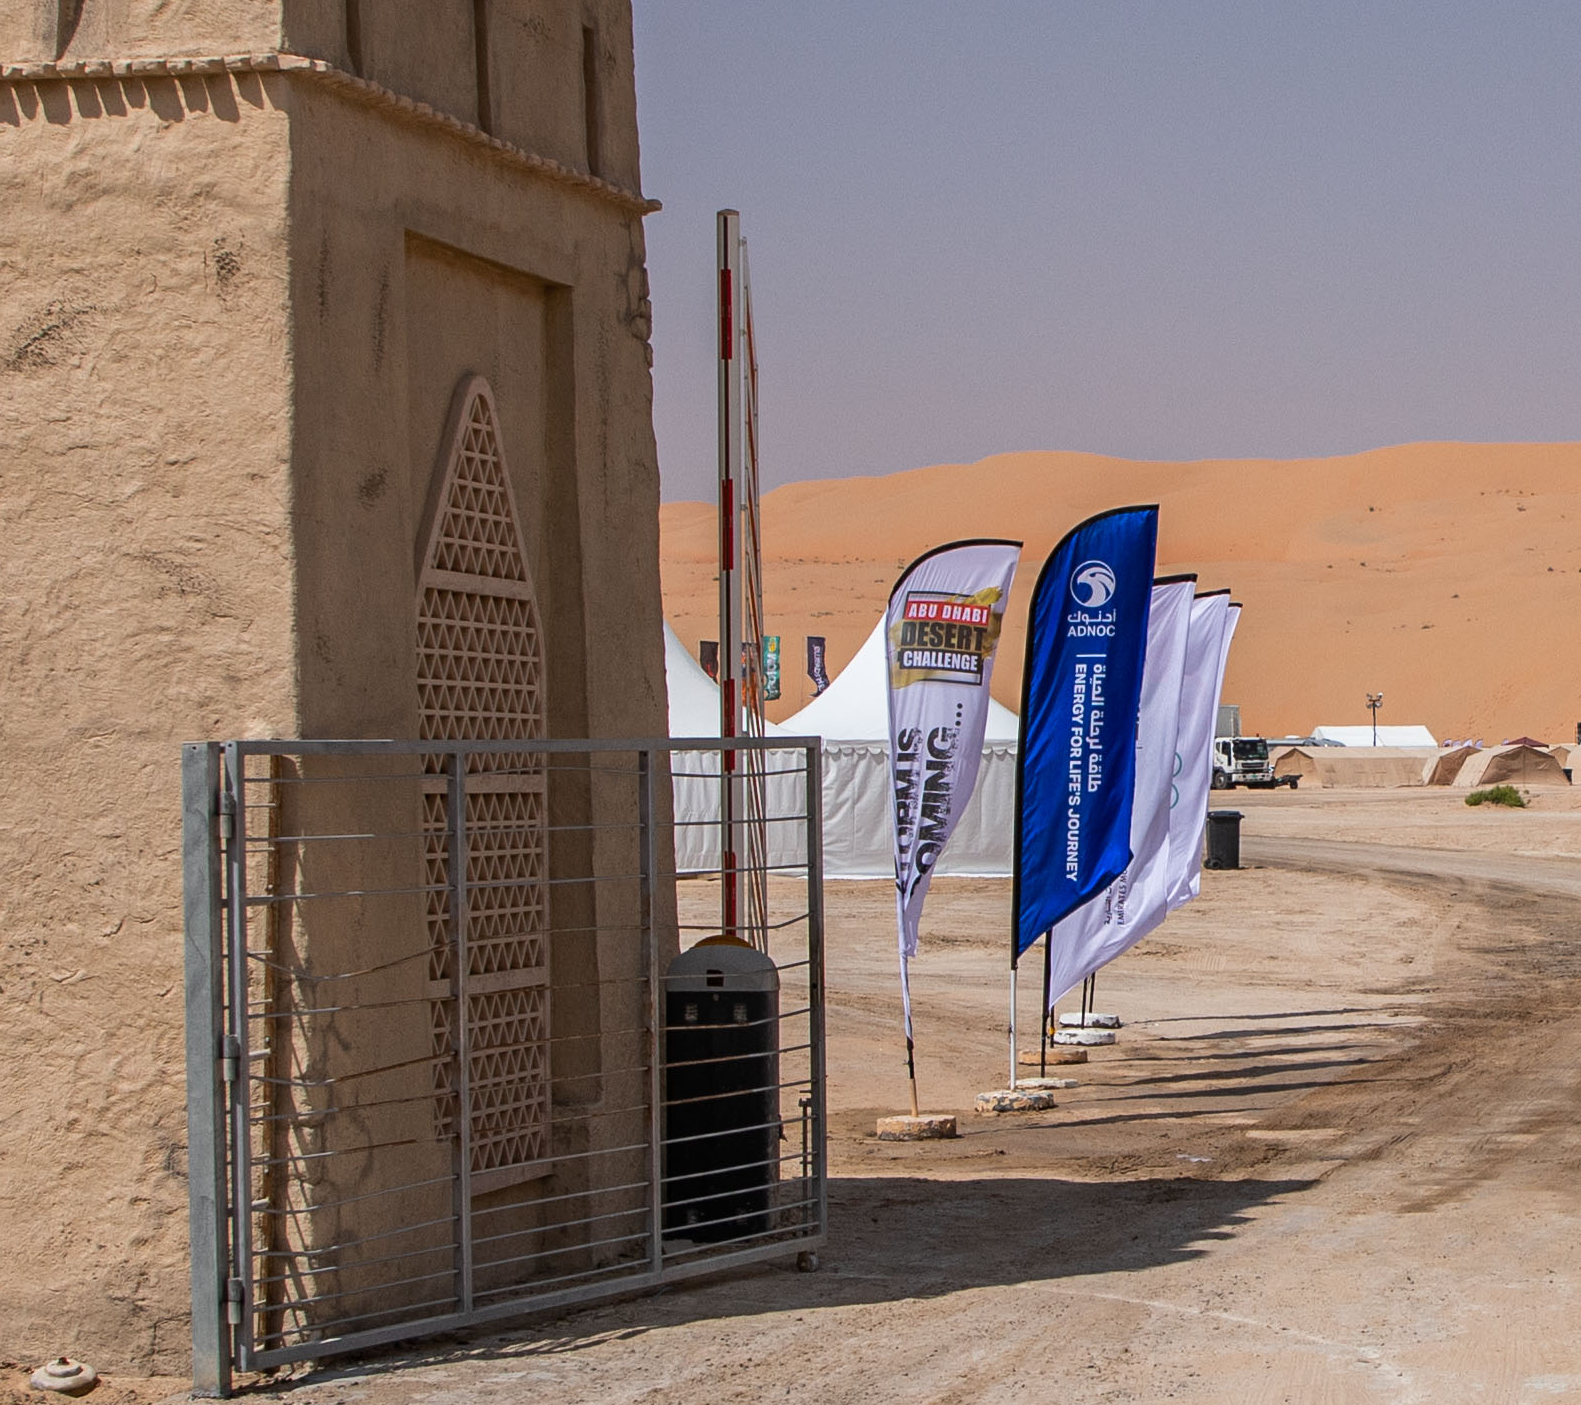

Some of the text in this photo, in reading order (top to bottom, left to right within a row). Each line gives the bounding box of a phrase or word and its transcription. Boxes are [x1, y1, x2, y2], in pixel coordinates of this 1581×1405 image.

[908, 603, 988, 624] ABU DHABI
[901, 621, 988, 652] DESERT
[1067, 625, 1116, 637] ADNOC
[903, 650, 979, 671] CHALLENGE
[1065, 663, 1088, 883] ENERGY FOR LIFE'S JOURNEY
